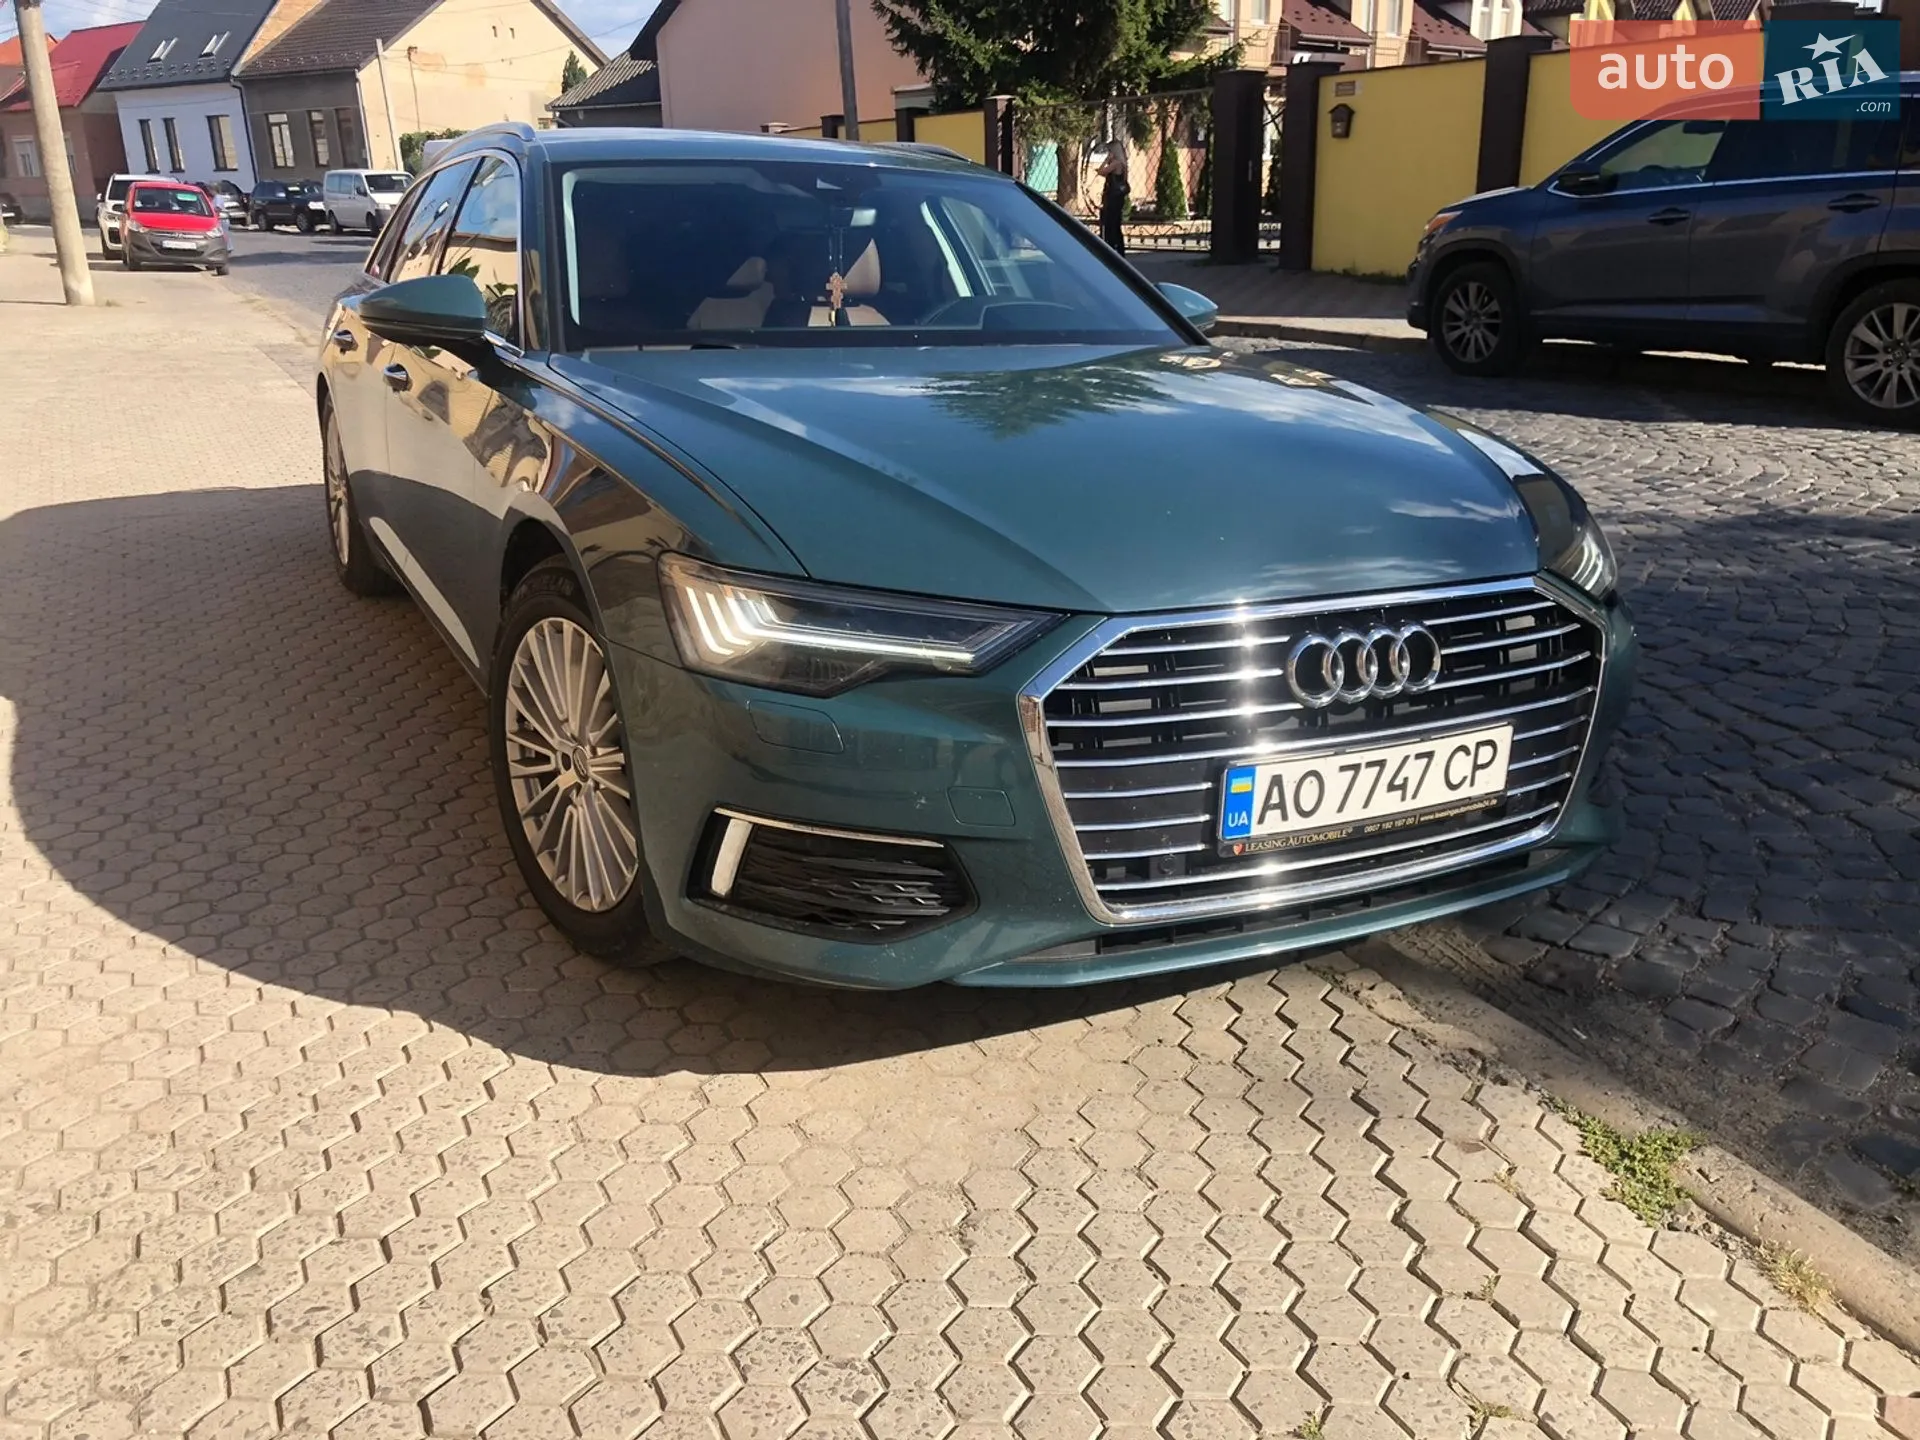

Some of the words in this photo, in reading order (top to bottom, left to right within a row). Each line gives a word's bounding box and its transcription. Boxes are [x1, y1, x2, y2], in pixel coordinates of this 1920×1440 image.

[1257, 770, 1325, 825] AO
[1336, 751, 1435, 814] 7747
[1443, 738, 1498, 792] CP
[1228, 811, 1249, 828] UA
[1245, 838, 1287, 852] LEASING
